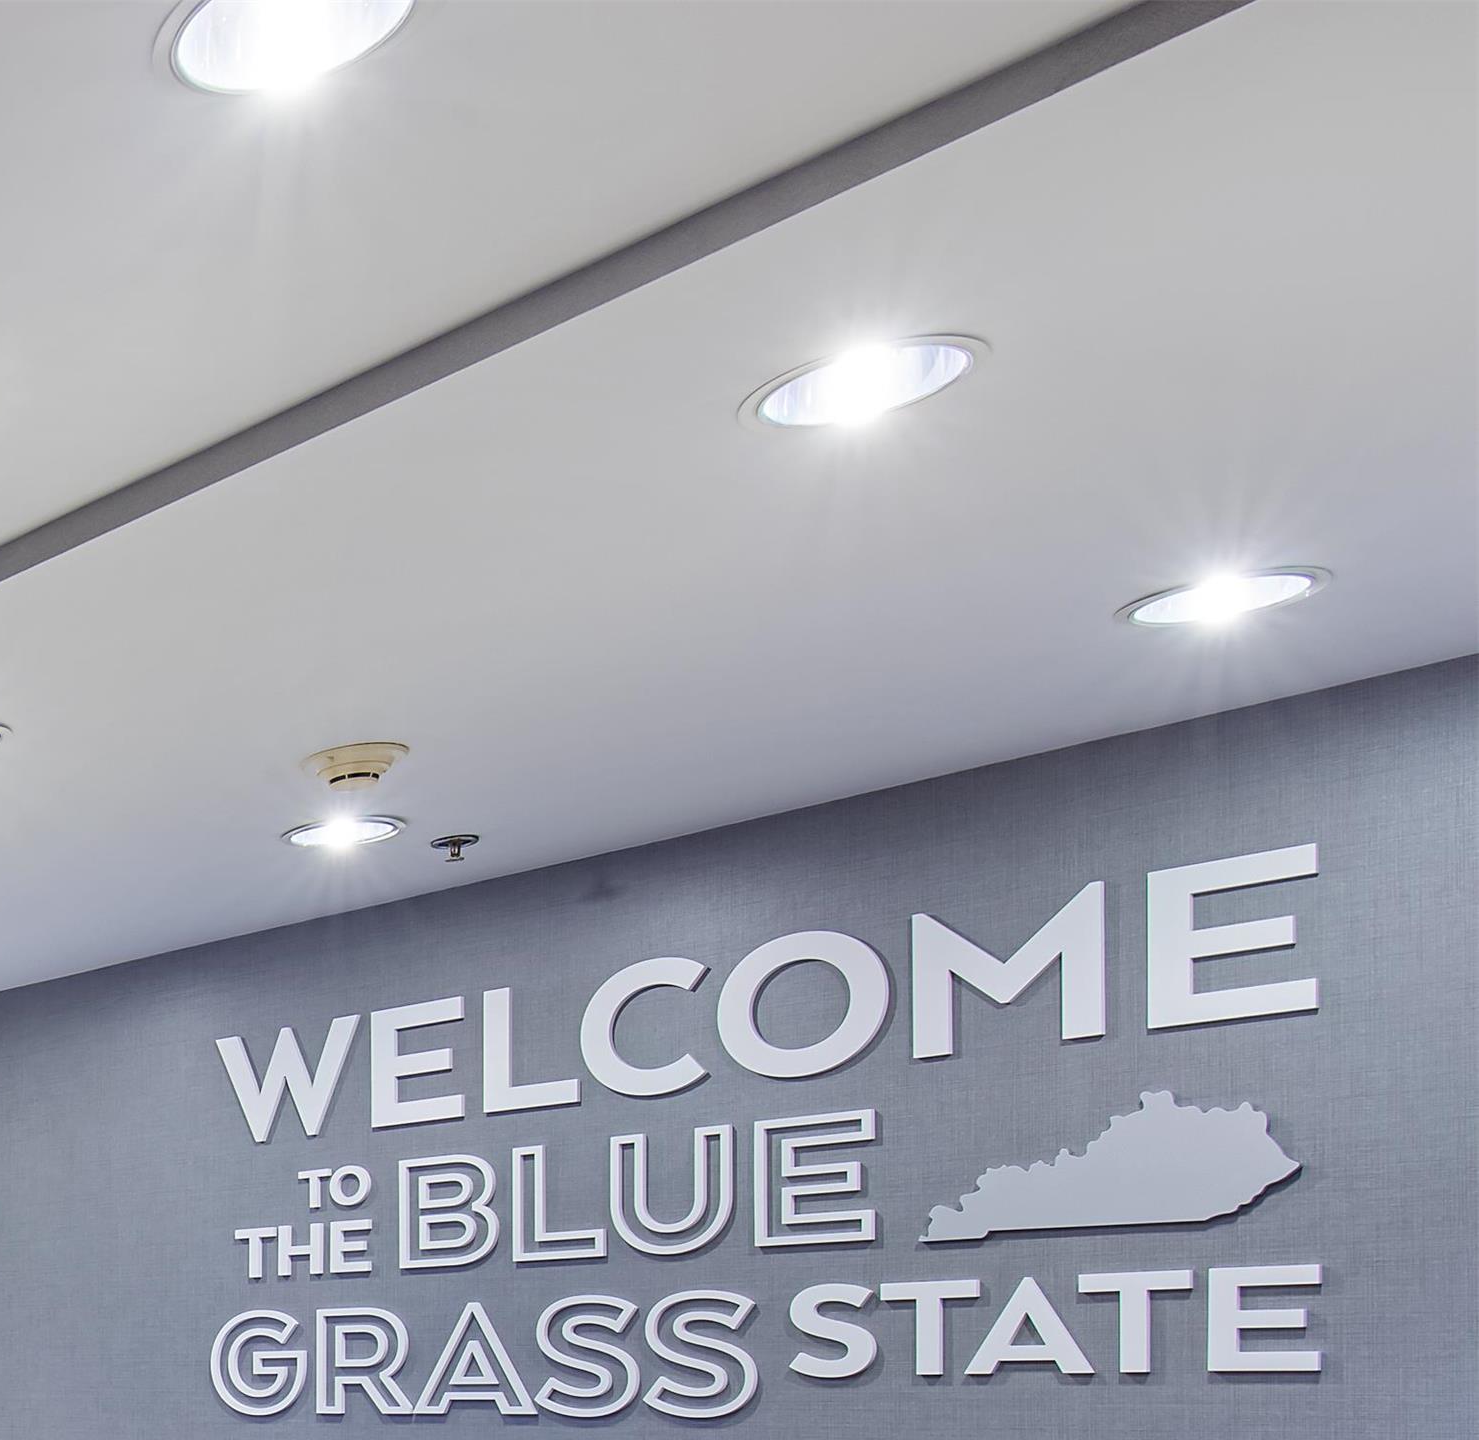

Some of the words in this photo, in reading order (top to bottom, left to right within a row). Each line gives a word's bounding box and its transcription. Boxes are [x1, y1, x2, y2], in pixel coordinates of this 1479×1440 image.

[215, 842, 1319, 1144] WELCOME
[235, 1219, 373, 1280] THE
[398, 1108, 876, 1272] BLUE
[298, 1165, 372, 1209] TO
[210, 1289, 760, 1419] GRASS
[788, 1264, 1323, 1380] STATE
